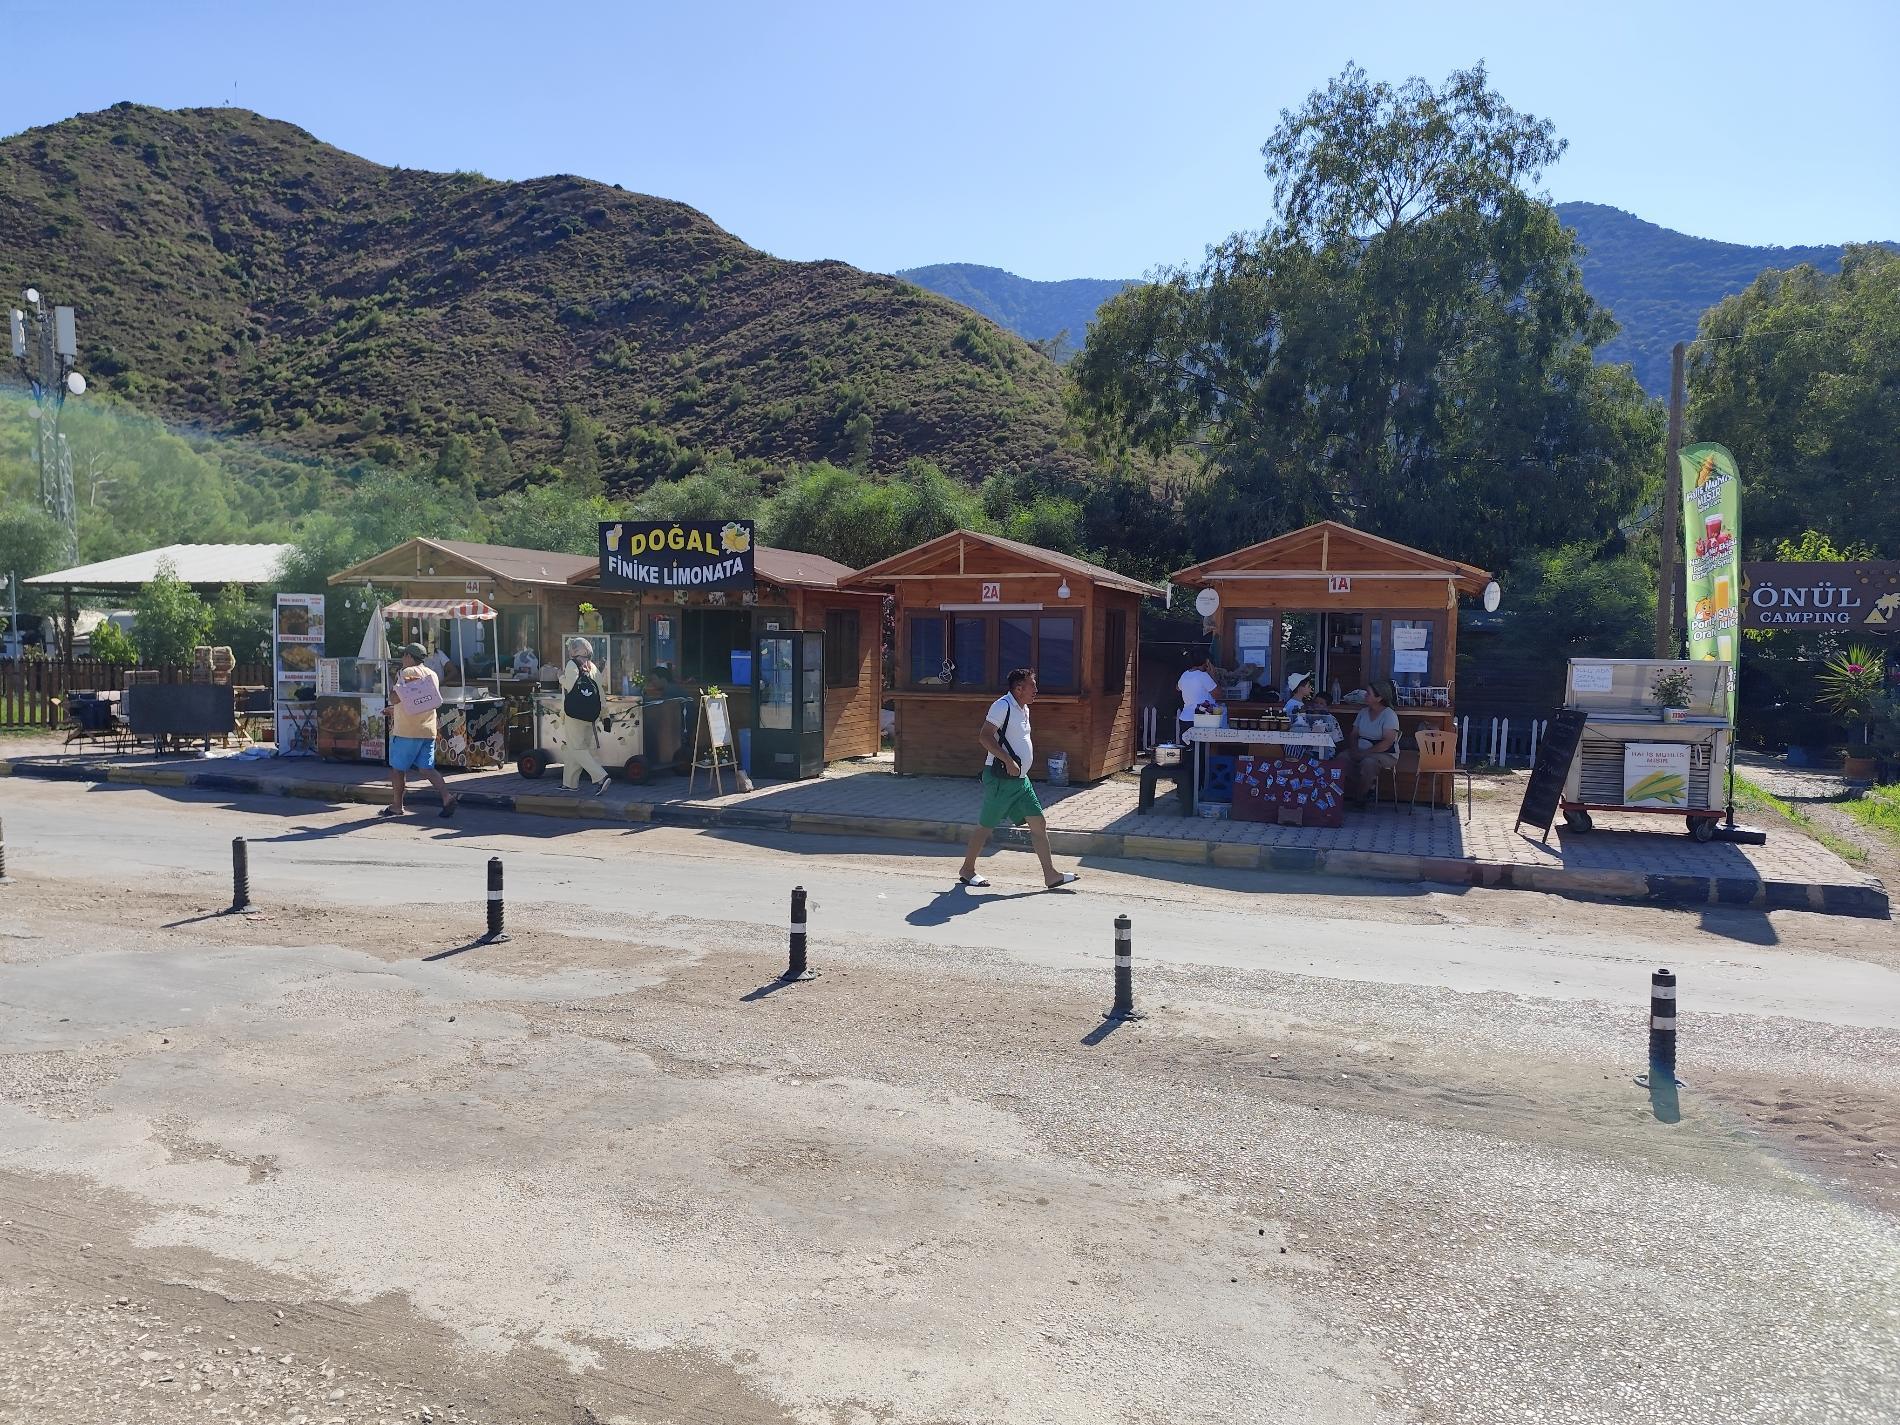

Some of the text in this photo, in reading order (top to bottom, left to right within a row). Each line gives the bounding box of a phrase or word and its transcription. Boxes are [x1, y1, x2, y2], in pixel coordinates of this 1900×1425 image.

[631, 523, 720, 556] DOĞAL
[608, 555, 744, 585] FİNİKE LİMONATA
[467, 581, 478, 591] 4A
[1331, 576, 1348, 590] 1A
[984, 585, 998, 599] 2A
[1752, 582, 1861, 607] ÖNÜL
[1760, 612, 1850, 624] CAMPING
